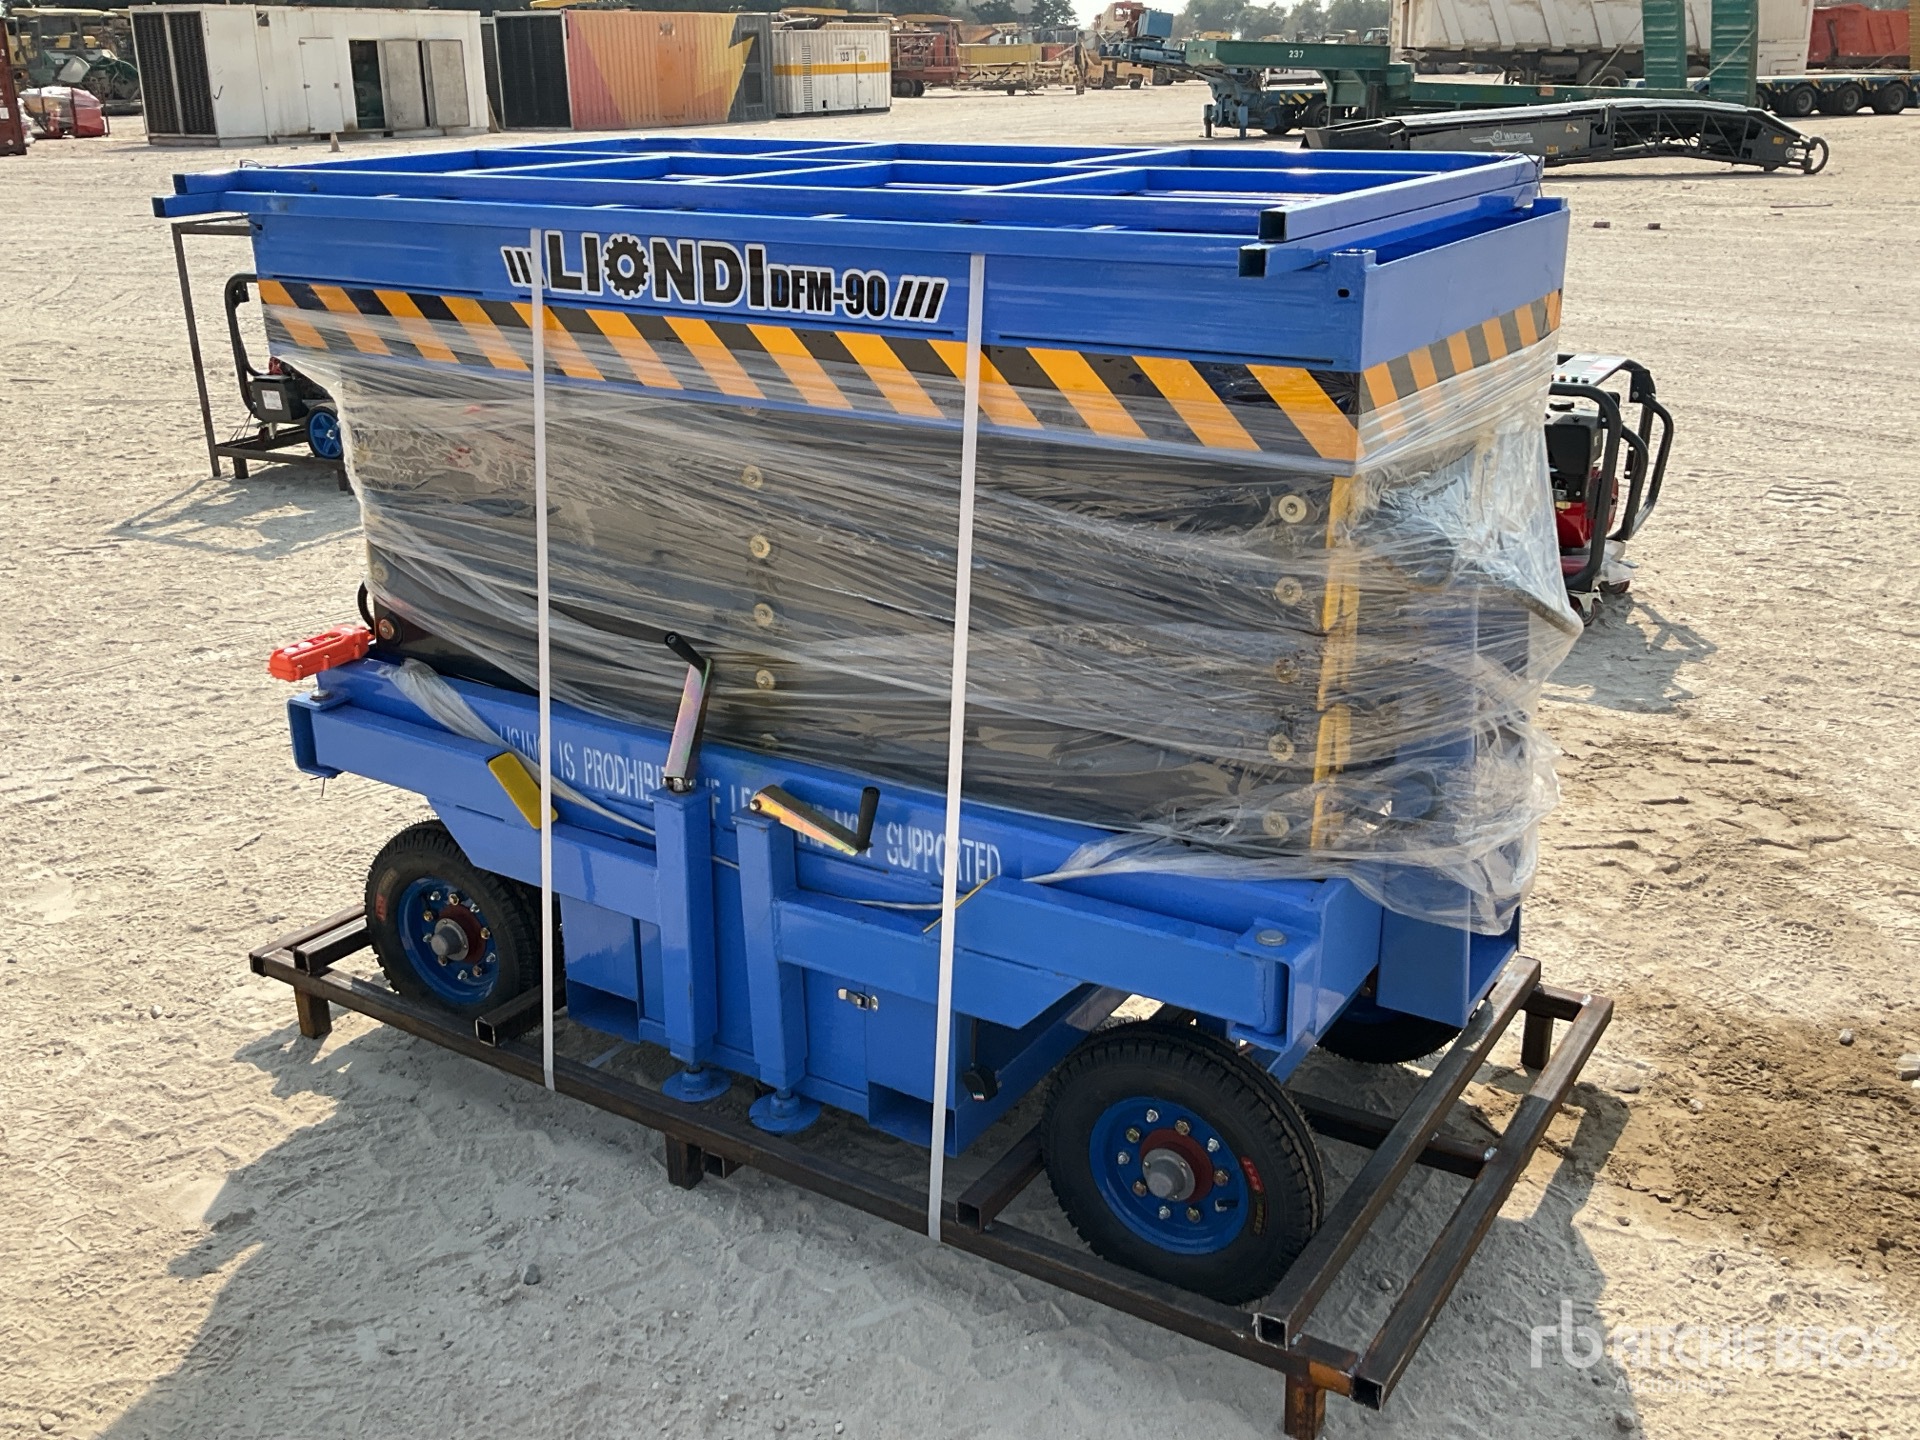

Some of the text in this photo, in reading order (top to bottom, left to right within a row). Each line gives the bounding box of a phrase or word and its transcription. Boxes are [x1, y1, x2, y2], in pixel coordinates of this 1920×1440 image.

[1288, 49, 1304, 58] 237
[544, 230, 890, 319] LIONDI DFM-90
[558, 740, 576, 781] IS
